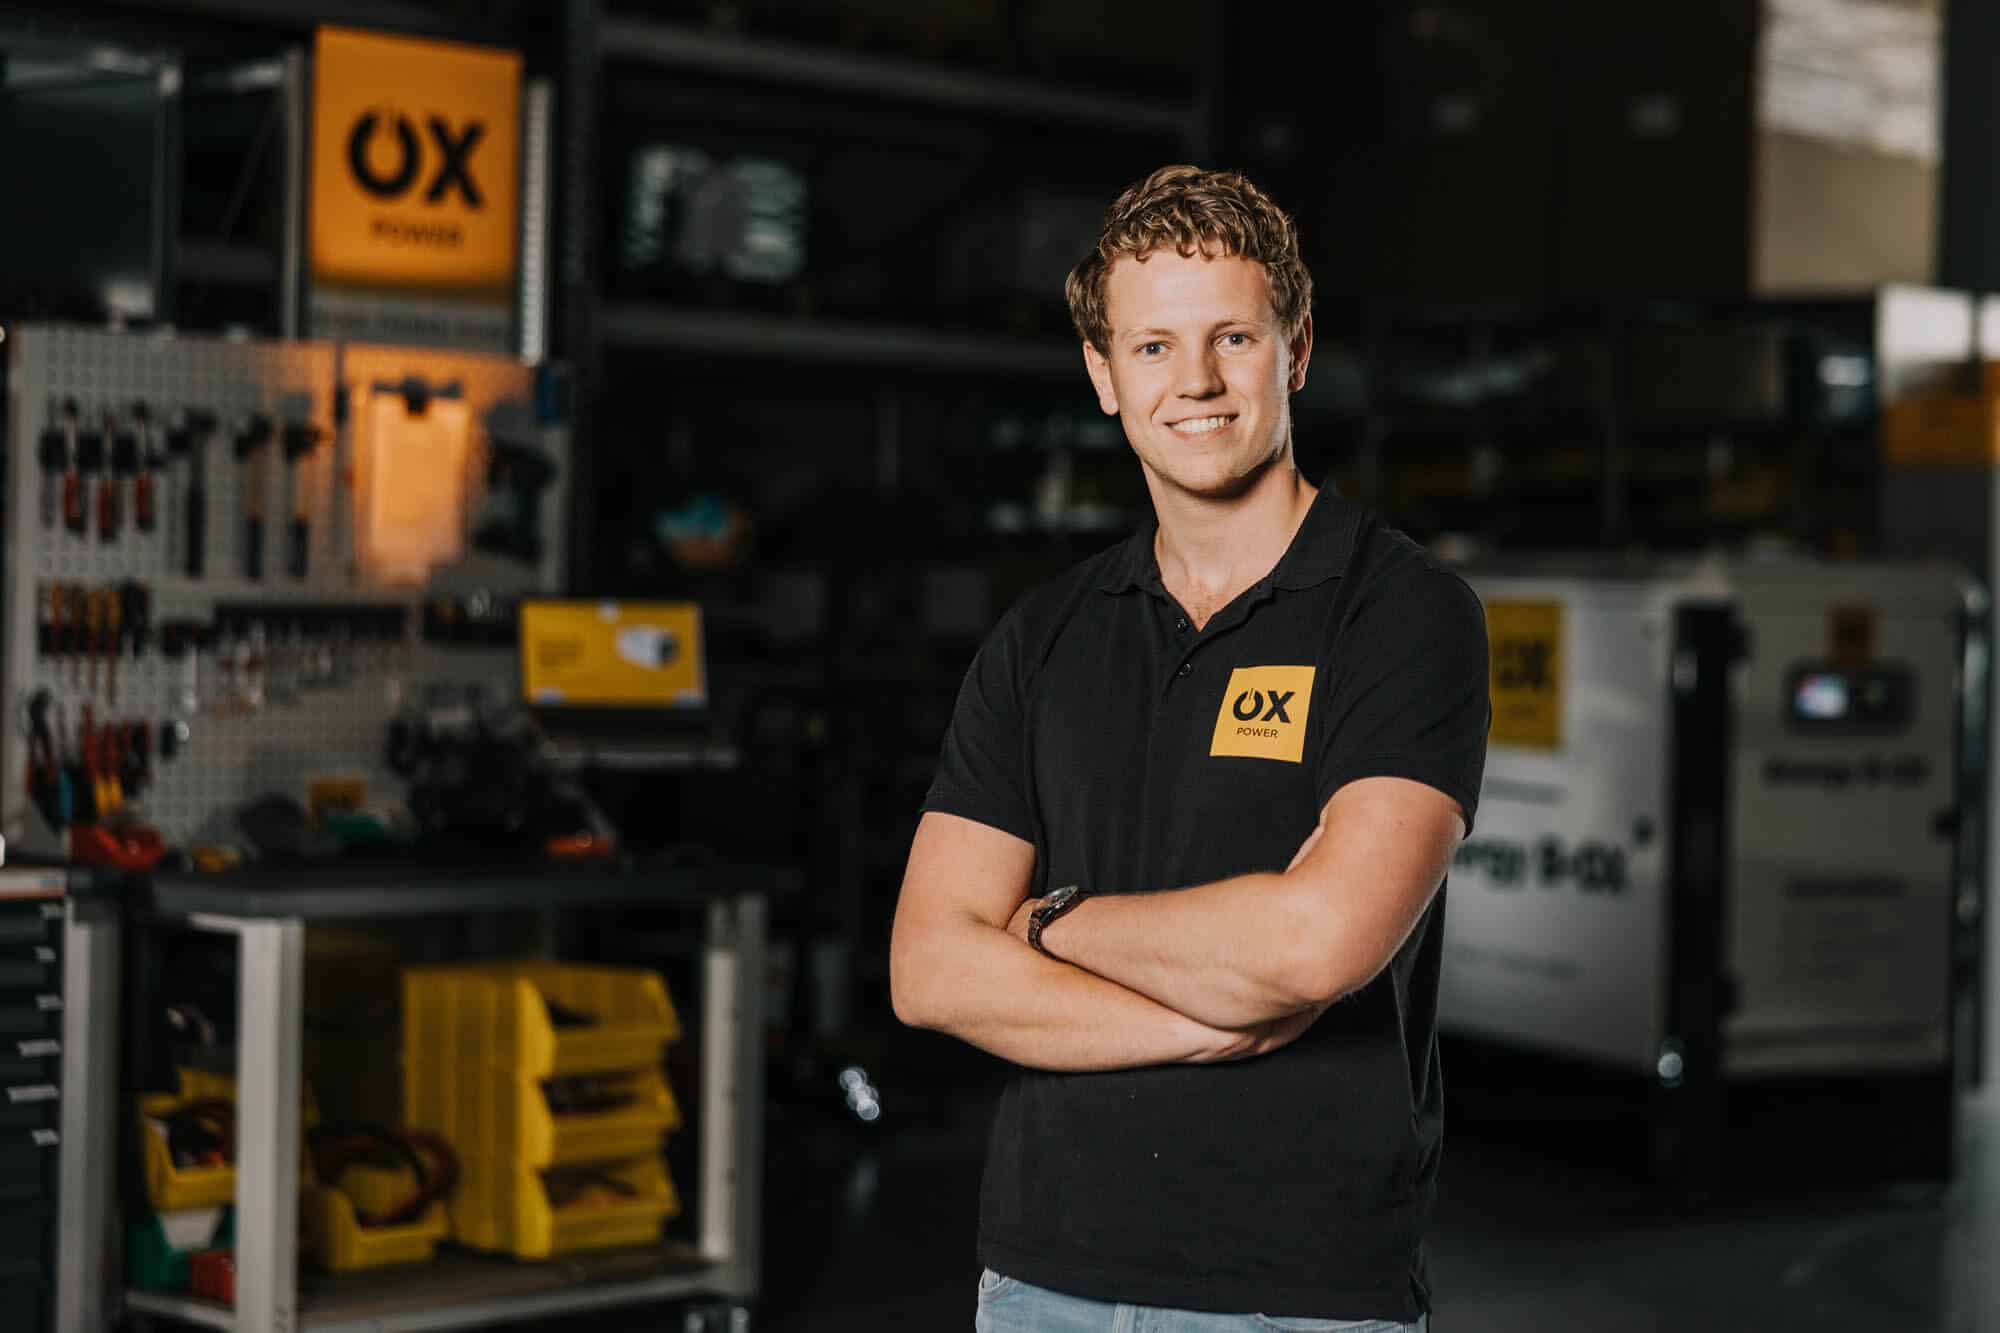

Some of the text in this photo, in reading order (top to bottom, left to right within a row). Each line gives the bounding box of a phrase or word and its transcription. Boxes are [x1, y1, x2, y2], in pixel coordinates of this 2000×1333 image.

[347, 109, 487, 211] OX
[371, 219, 463, 246] POWER
[1233, 688, 1296, 723] OX
[1236, 727, 1279, 738] POWER
